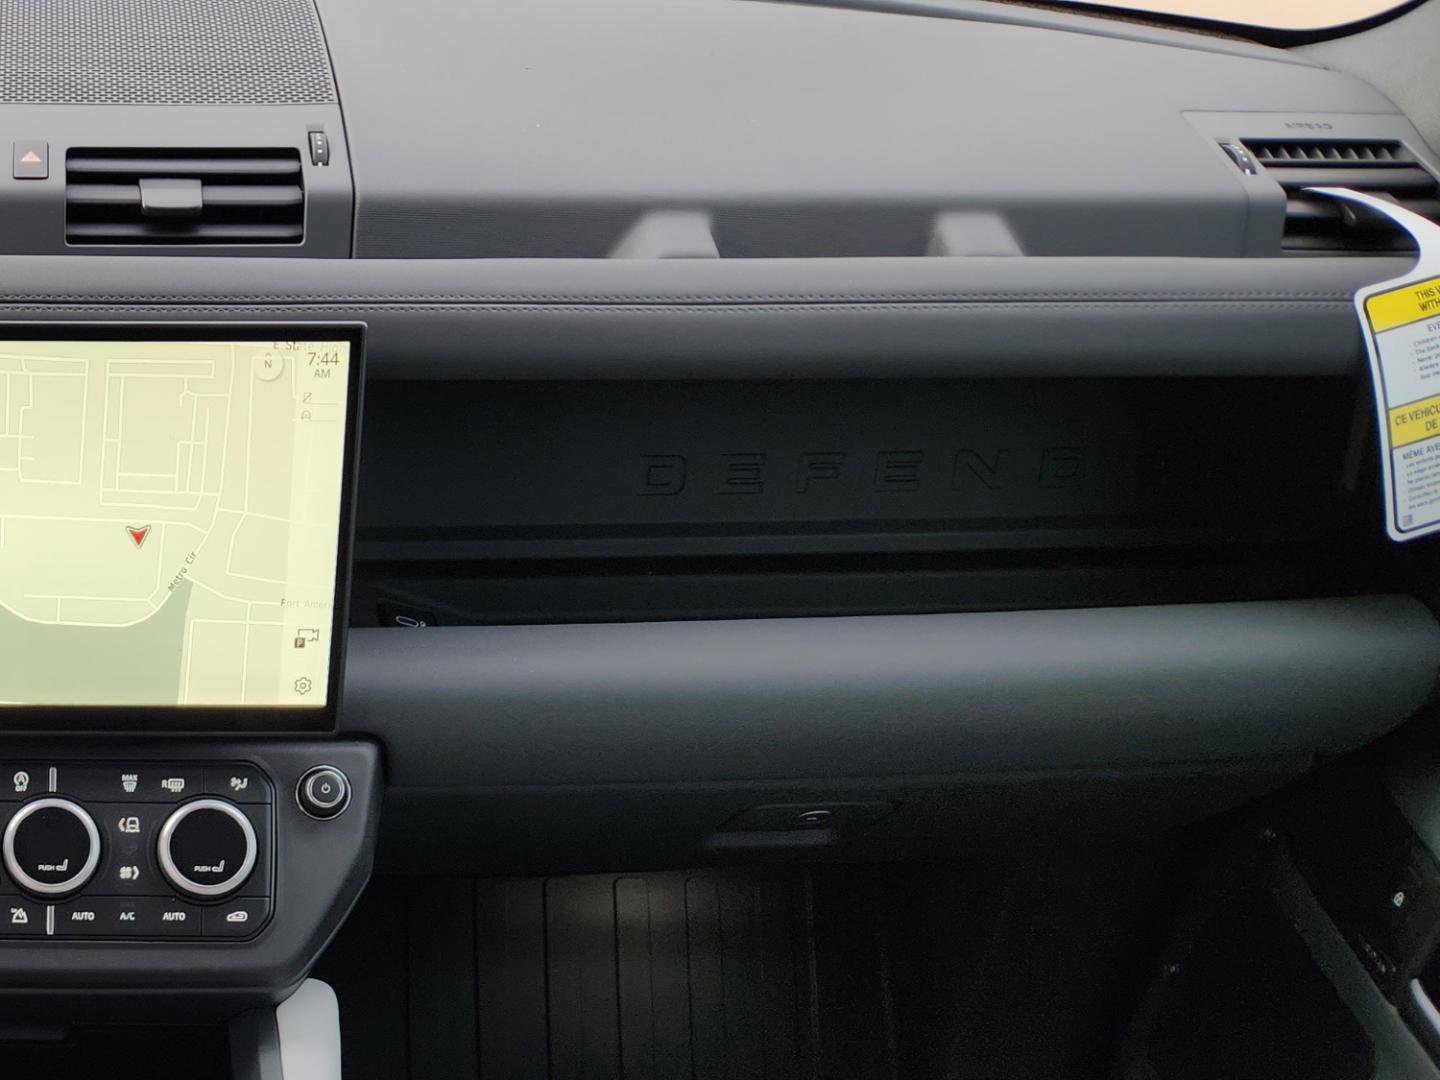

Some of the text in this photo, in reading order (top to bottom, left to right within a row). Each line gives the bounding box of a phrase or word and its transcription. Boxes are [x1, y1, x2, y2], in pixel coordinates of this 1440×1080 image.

[264, 359, 273, 369] N
[307, 352, 340, 366] 7:44
[313, 369, 331, 379] AM
[161, 779, 168, 788] R
[71, 911, 95, 921] AUTO
[119, 911, 136, 921] A/C
[162, 911, 186, 921] AUTO
